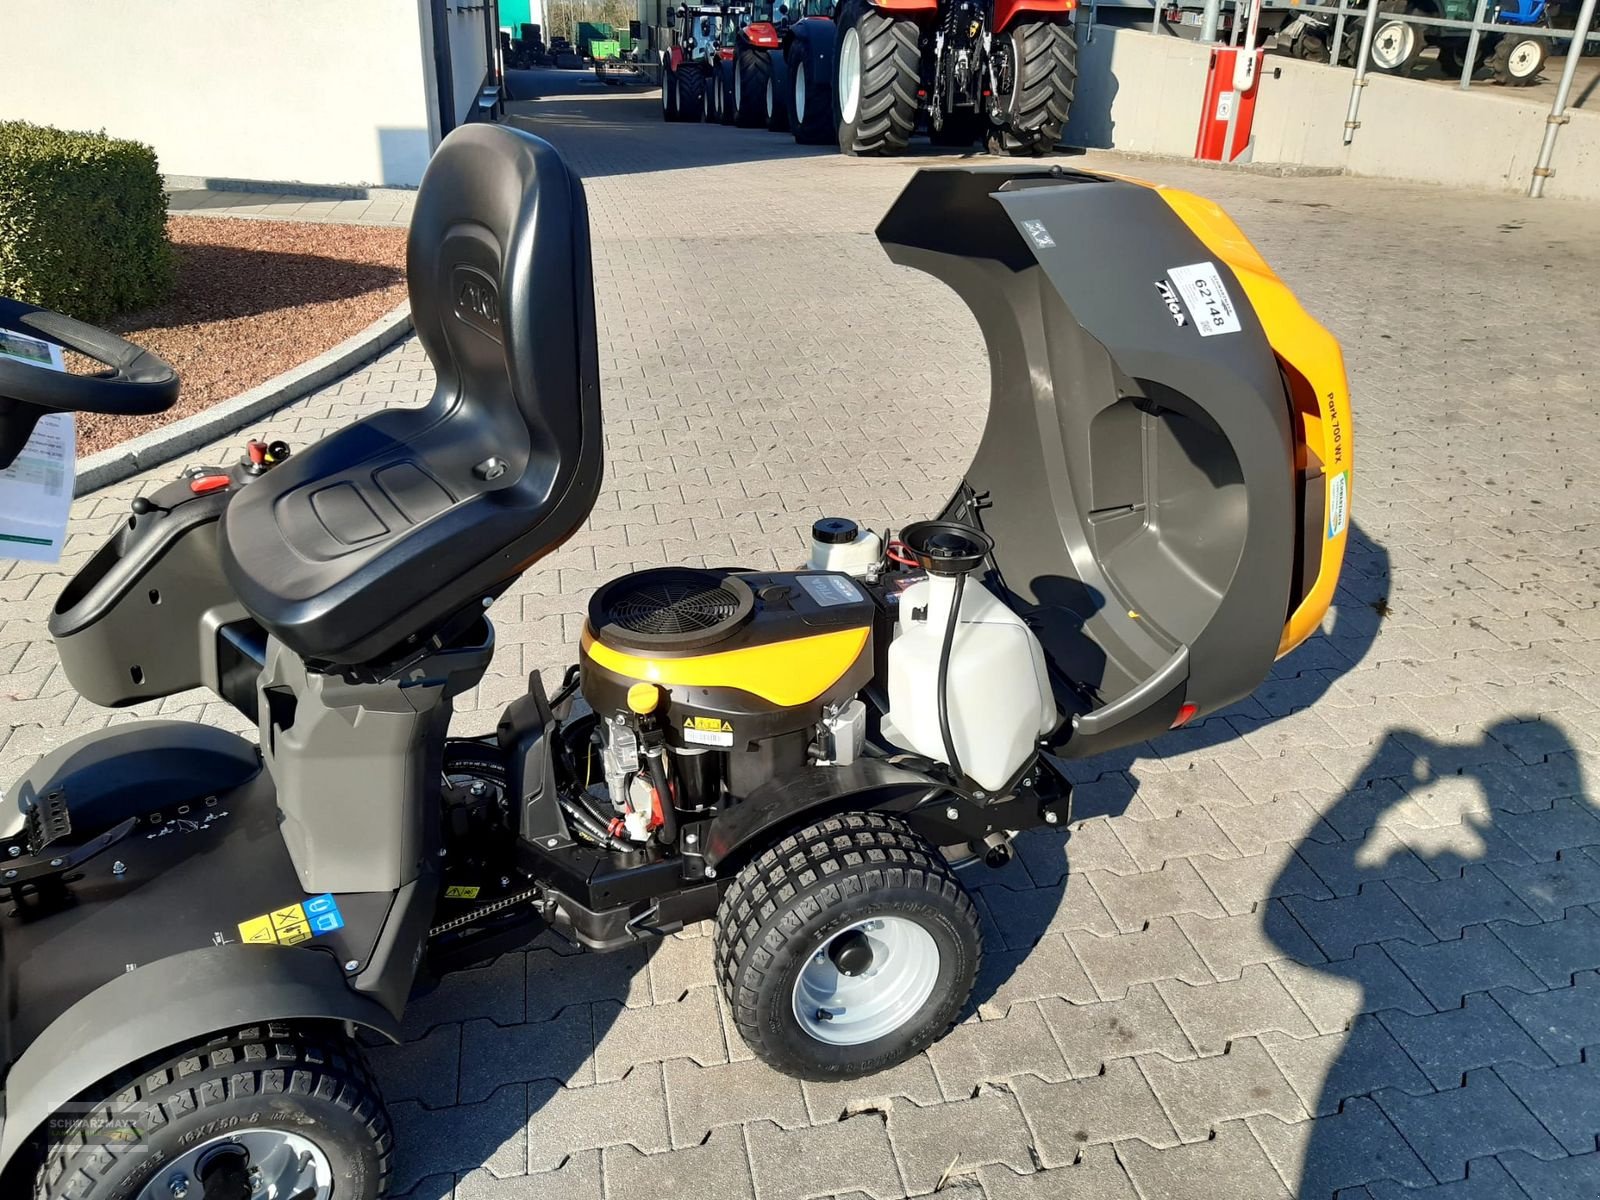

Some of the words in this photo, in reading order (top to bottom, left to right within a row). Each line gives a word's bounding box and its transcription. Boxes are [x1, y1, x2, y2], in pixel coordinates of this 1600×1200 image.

[1155, 280, 1185, 327] STIGA
[1195, 279, 1225, 326] 62148
[1327, 392, 1338, 421] Park
[1332, 422, 1342, 443] 700
[1334, 443, 1343, 463] WX
